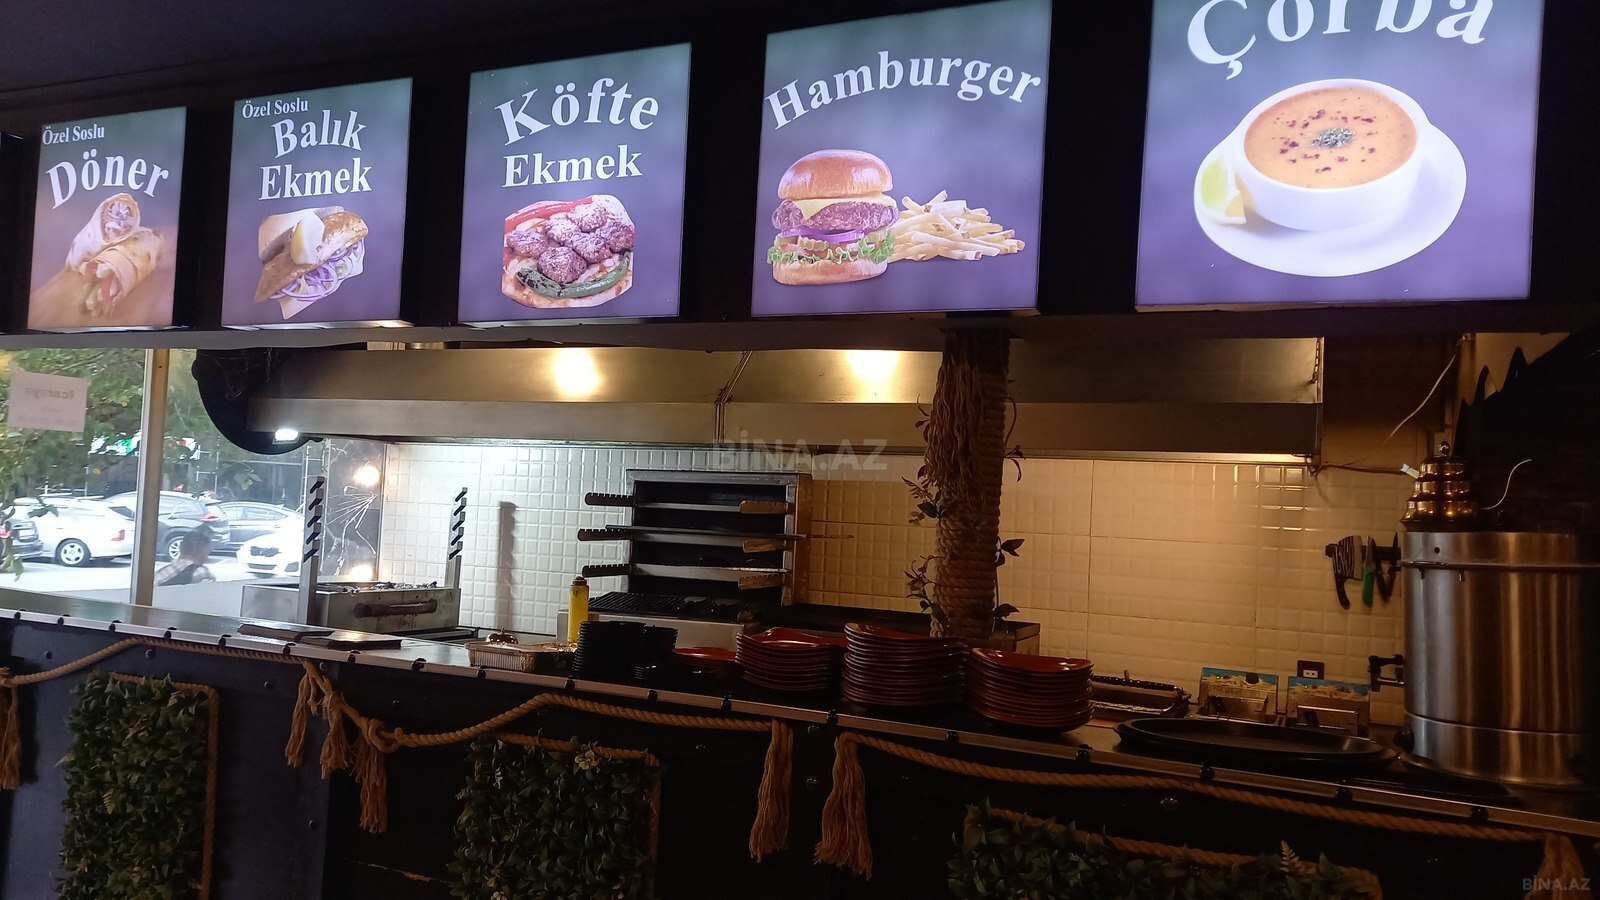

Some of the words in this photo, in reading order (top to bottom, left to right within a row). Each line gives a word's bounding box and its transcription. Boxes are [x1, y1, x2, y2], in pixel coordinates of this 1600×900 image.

[242, 101, 271, 119] Özel
[273, 97, 309, 116] Soslu
[495, 78, 659, 145] Köfte
[765, 52, 1042, 128] Hamburger
[42, 125, 70, 145] Özel
[72, 124, 105, 143] Soslu
[271, 109, 367, 158] Balık
[46, 149, 169, 209] Döner
[258, 158, 373, 200] Ekmek
[501, 145, 642, 188] Ekmek
